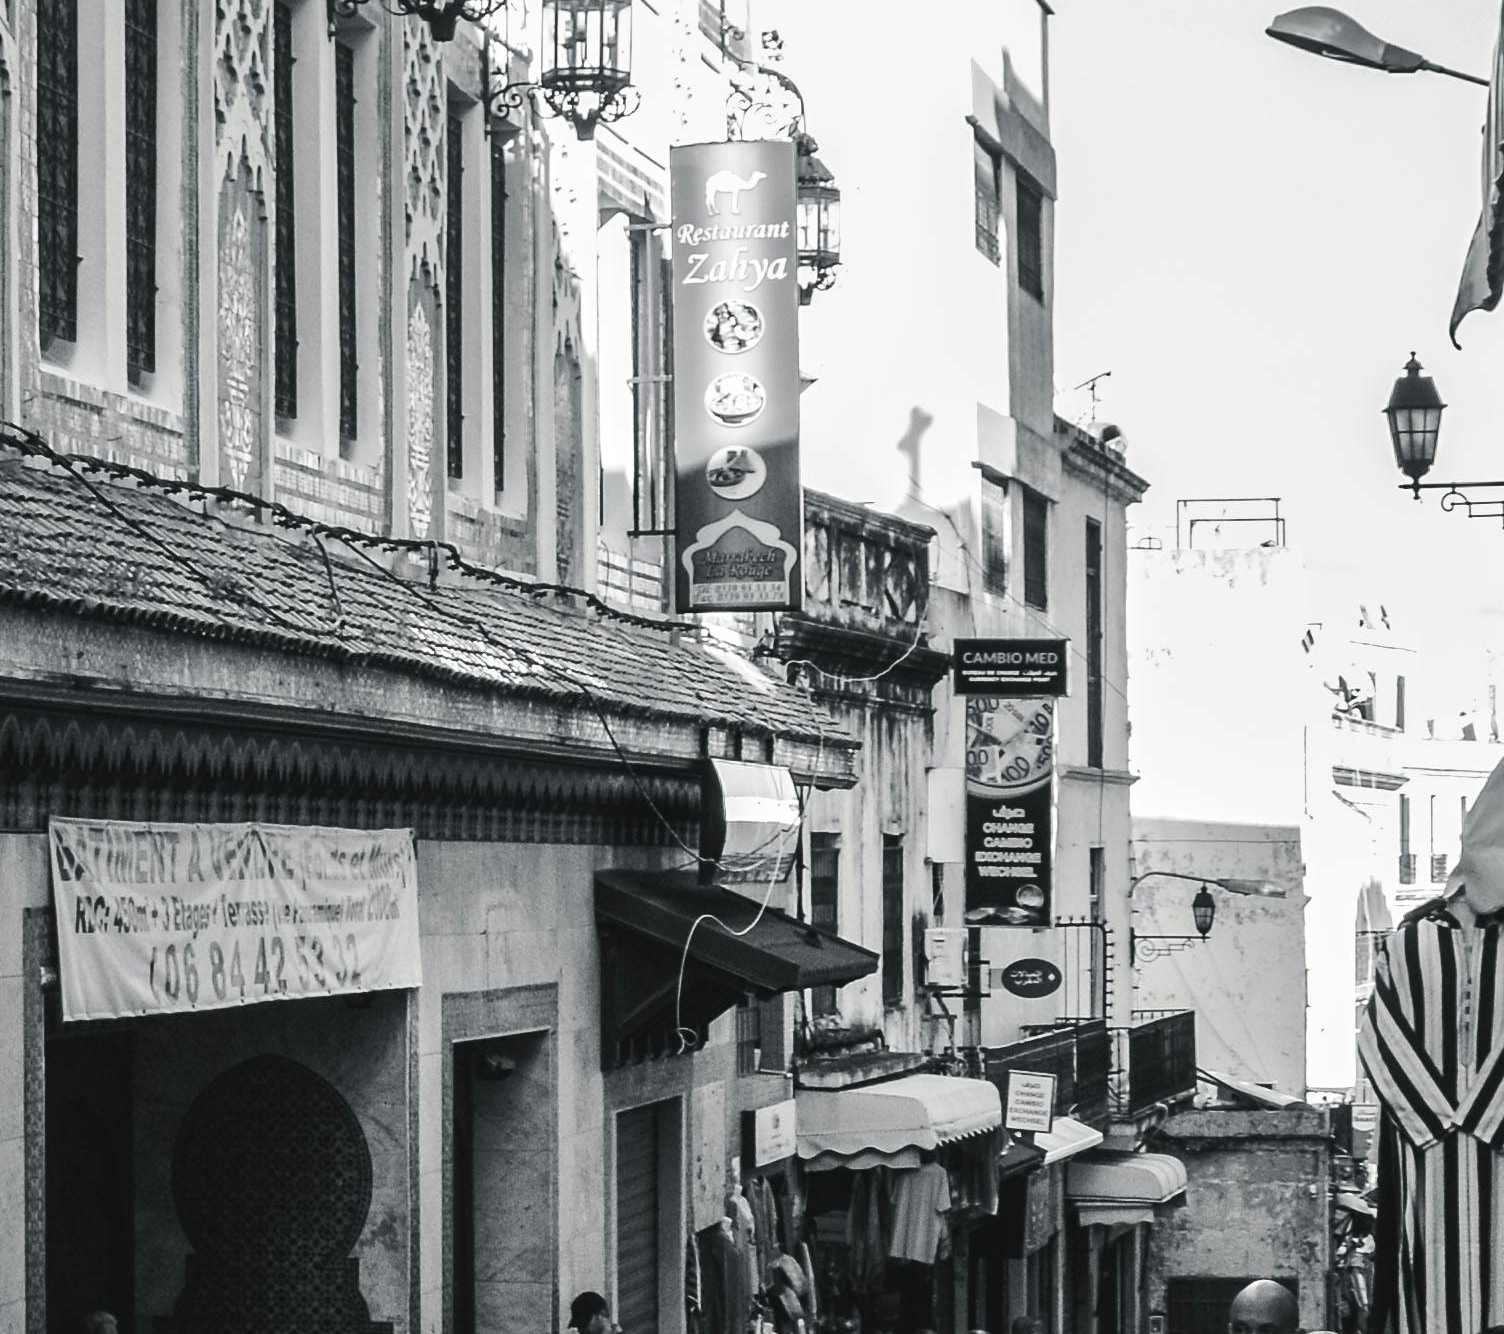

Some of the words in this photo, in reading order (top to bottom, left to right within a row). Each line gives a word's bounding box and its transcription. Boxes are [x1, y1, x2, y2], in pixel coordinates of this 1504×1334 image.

[677, 220, 790, 246] Restaurant
[682, 247, 788, 292] Zahya
[962, 652, 1023, 664] CAMBIO
[1025, 652, 1058, 664] MED
[982, 822, 1035, 834] CHANGE
[209, 940, 245, 1001] 84
[254, 936, 287, 995] 42
